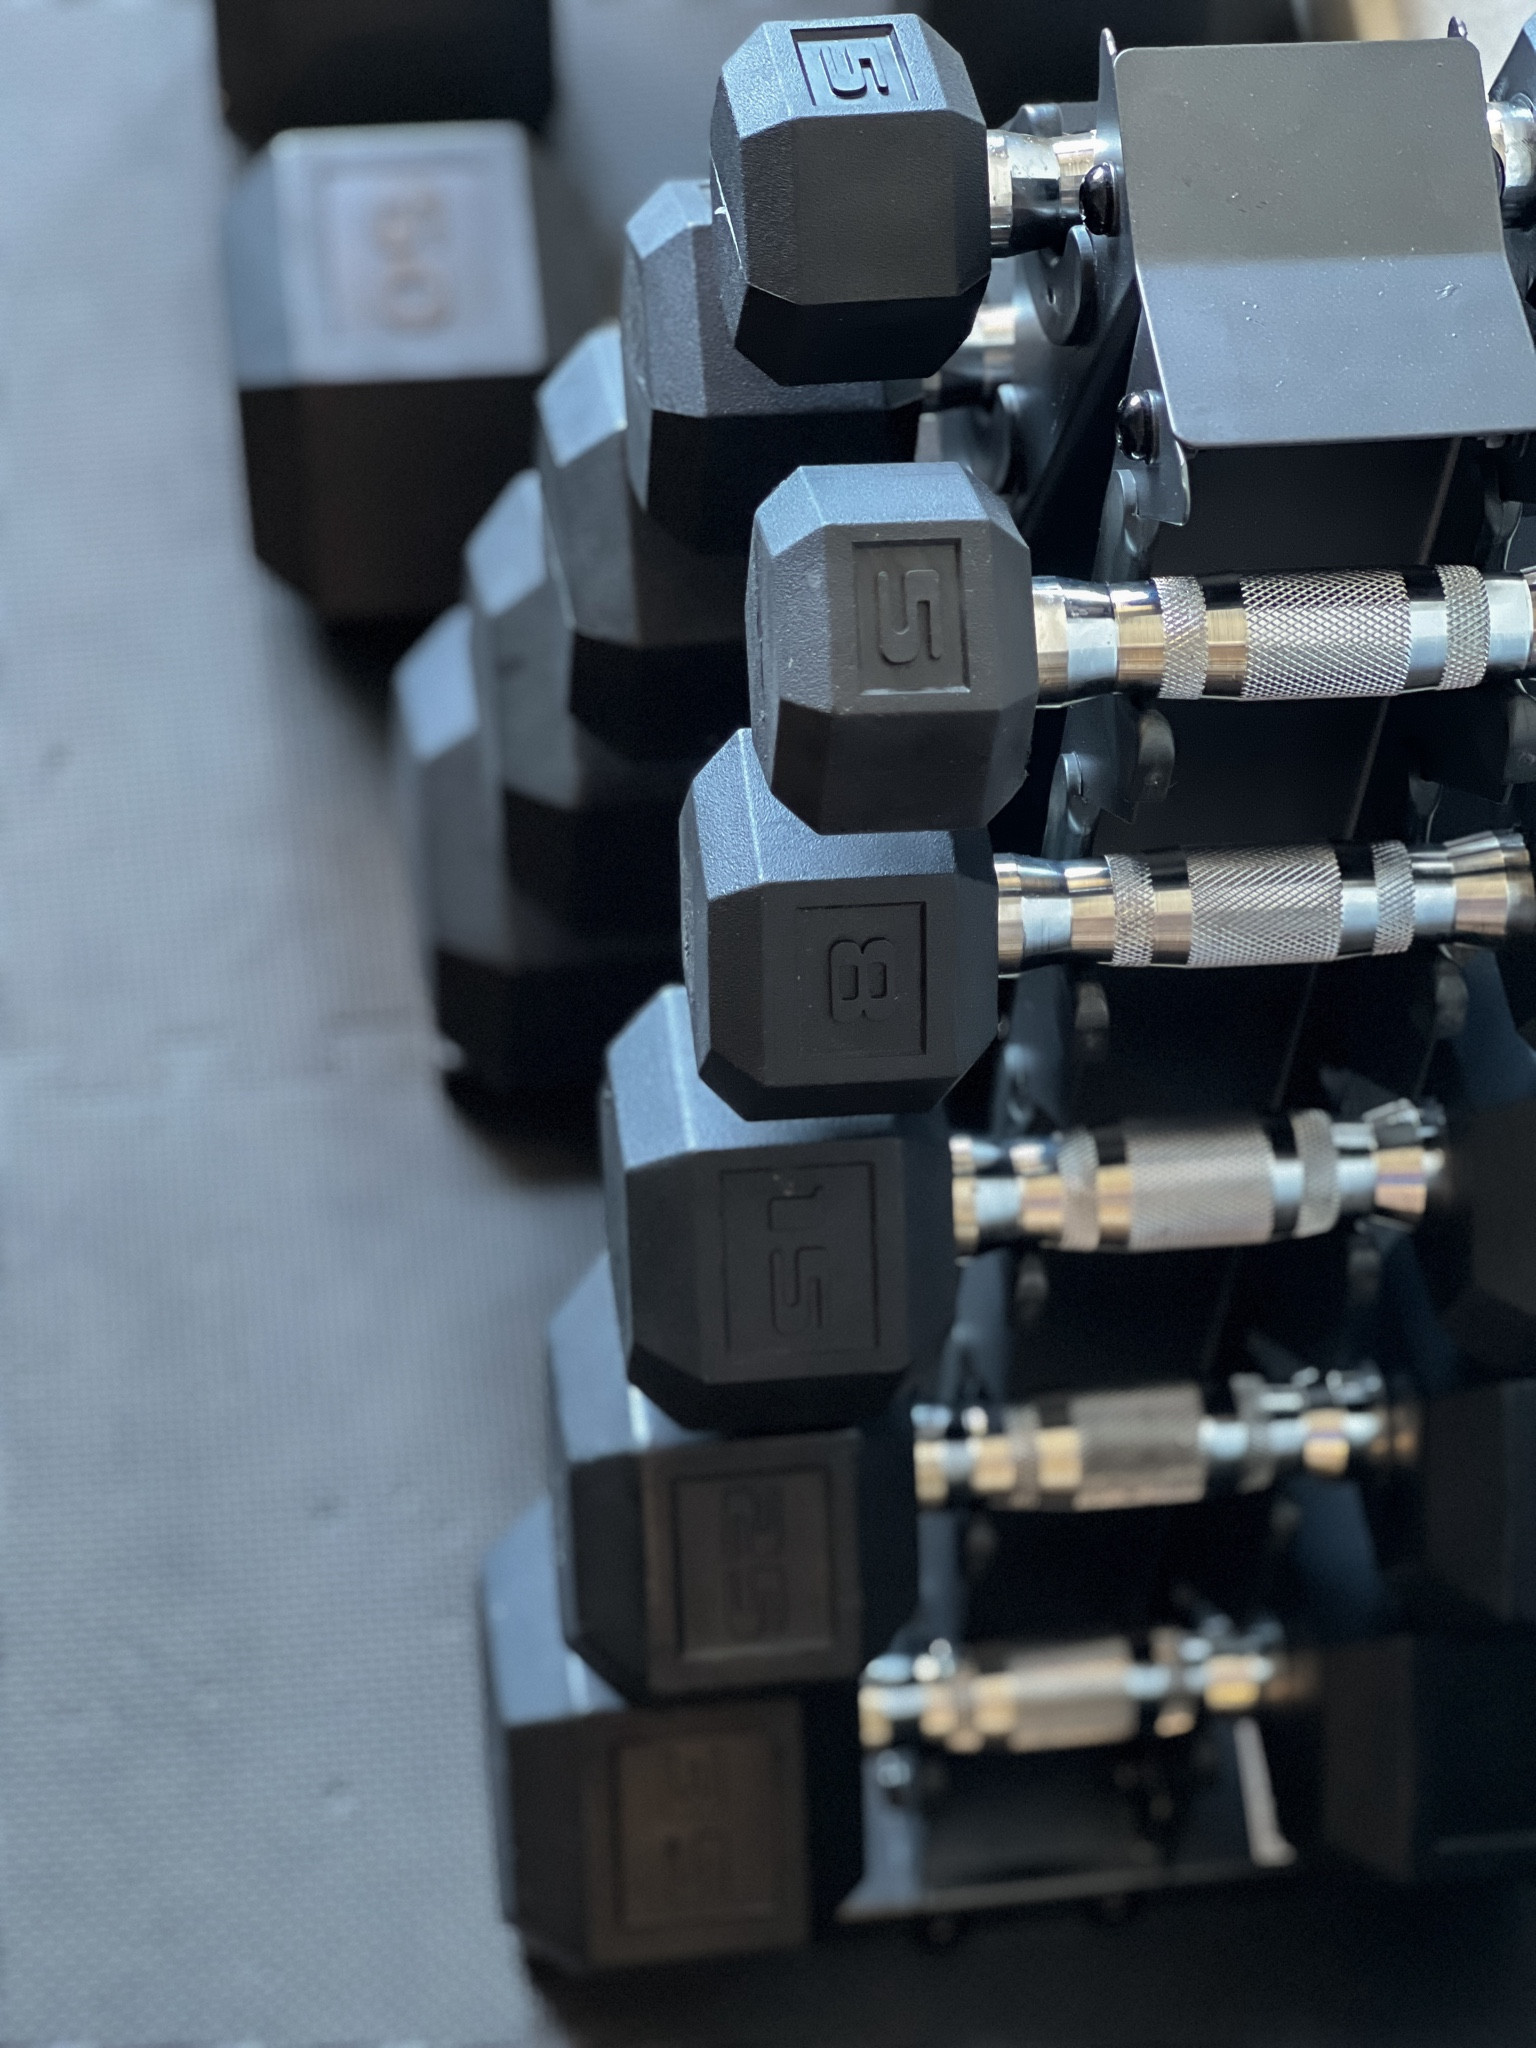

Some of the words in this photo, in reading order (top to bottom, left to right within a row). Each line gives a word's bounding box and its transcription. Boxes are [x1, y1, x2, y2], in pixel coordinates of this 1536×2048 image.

[819, 44, 889, 98] 5
[876, 569, 941, 666] 5
[767, 1182, 832, 1337] 15
